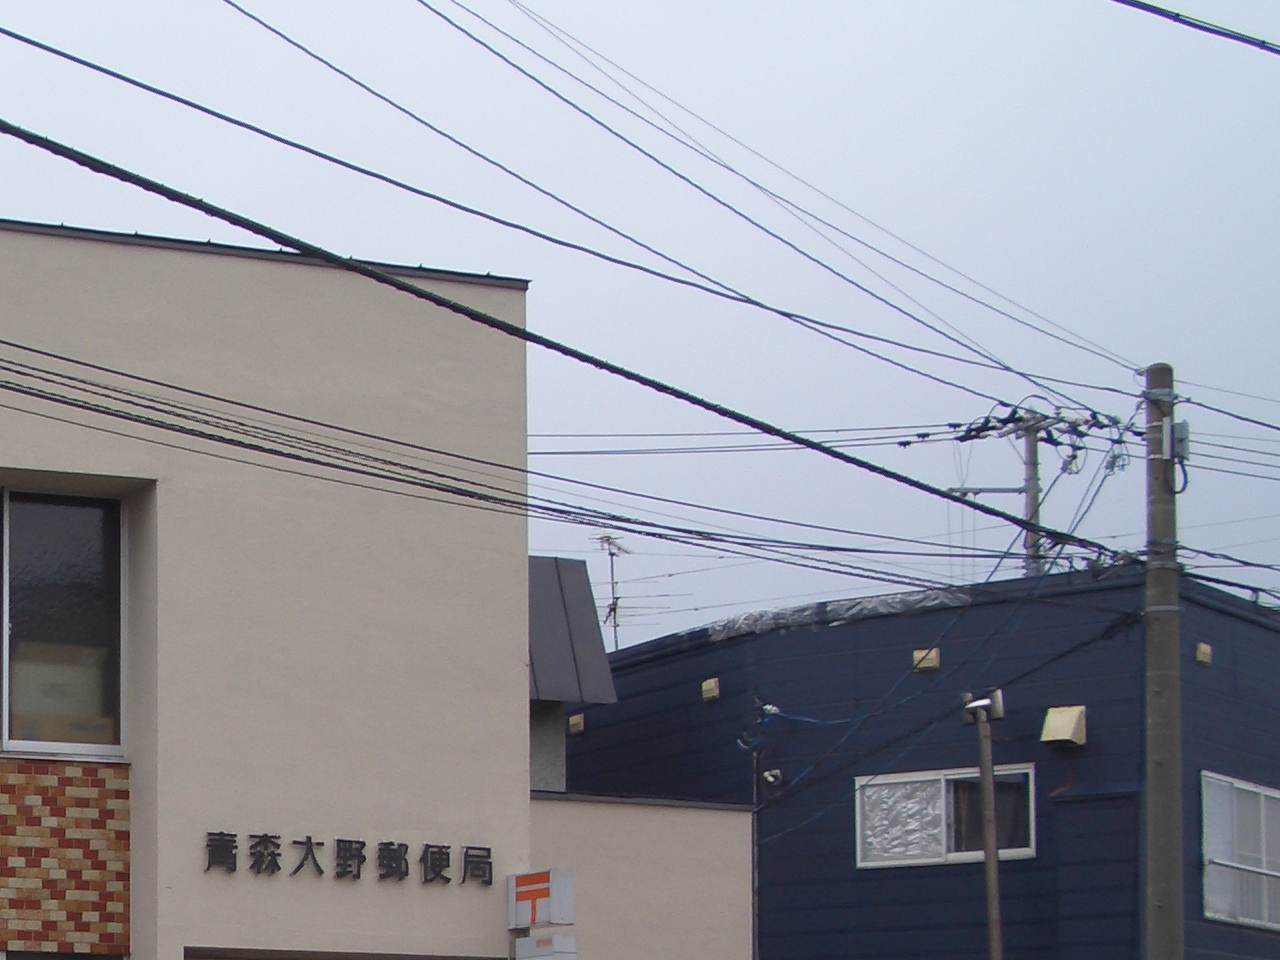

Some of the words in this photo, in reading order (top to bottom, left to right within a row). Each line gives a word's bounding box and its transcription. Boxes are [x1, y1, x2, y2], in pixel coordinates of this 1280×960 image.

[204, 831, 494, 887] 青森大野郵便局
